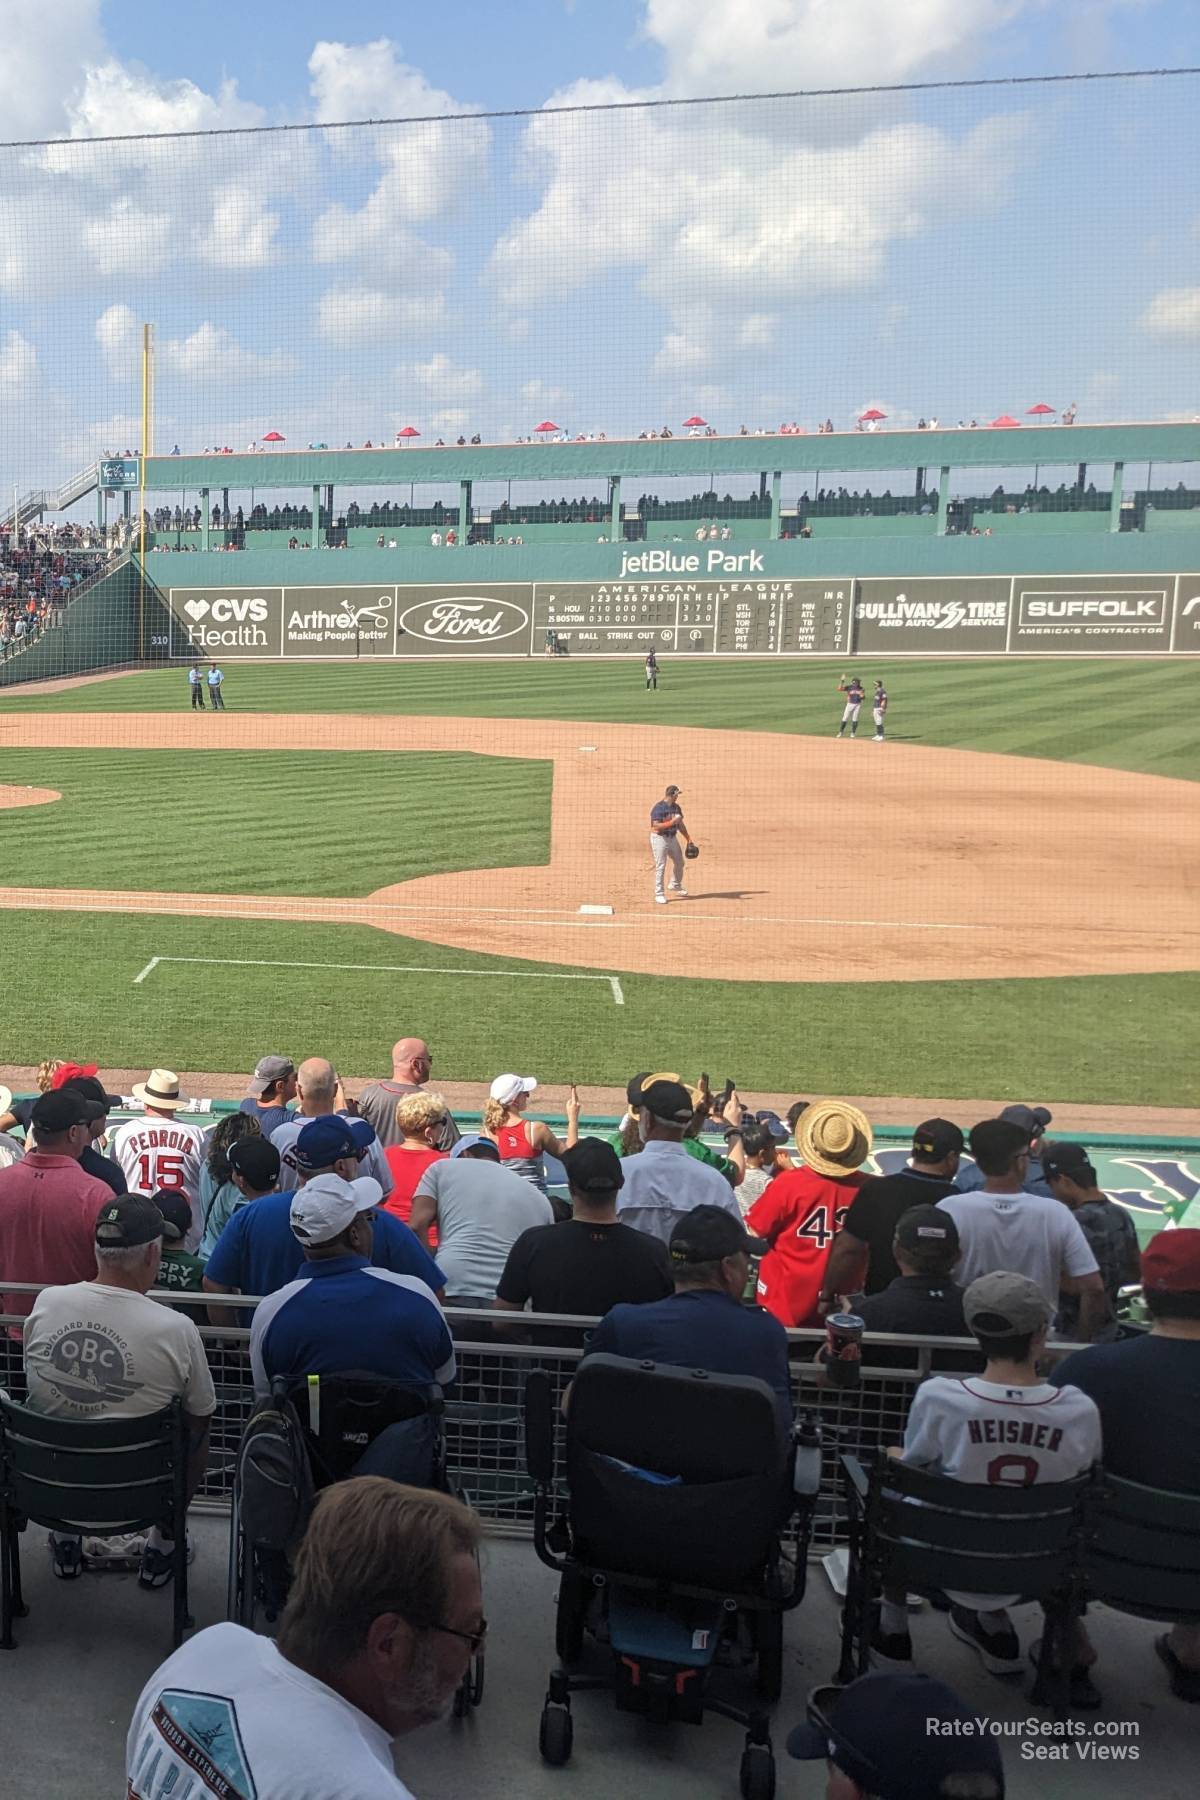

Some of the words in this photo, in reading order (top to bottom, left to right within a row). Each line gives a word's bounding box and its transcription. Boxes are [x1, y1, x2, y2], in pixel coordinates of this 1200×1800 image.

[620, 550, 699, 578] jetBlue
[707, 549, 764, 572] Park
[598, 584, 697, 593] AMERICAN
[719, 583, 793, 592] LEAGUE
[212, 598, 268, 622] CVS
[855, 600, 941, 619] SULLIVAN
[967, 602, 1008, 618] TIRE
[1028, 600, 1157, 617] SUFFOLK
[288, 609, 360, 629] Arthrex
[423, 603, 504, 635] Ford
[878, 619, 904, 627] AND
[905, 619, 936, 627] AUTO
[960, 618, 1006, 627] SERVICE
[151, 636, 168, 645] 310
[187, 624, 268, 646] Health
[288, 631, 323, 642] Making
[324, 630, 356, 641] People
[358, 630, 388, 640] Better
[557, 632, 571, 640] BAT
[579, 632, 599, 640] BALL
[607, 632, 634, 640] STRIKE
[637, 631, 655, 639] OUT
[1018, 627, 1081, 635] AMERICA'S
[1085, 627, 1164, 635] CONTRACTOR
[129, 1130, 194, 1155] PEDROIA
[139, 1154, 184, 1191] 15
[159, 1260, 194, 1277] PPY
[158, 1270, 192, 1287] PPY
[87, 1321, 128, 1350] BOATING
[61, 1337, 115, 1368] OBC
[63, 1400, 109, 1412] AMERICA
[967, 1419, 1065, 1452] HEISNER
